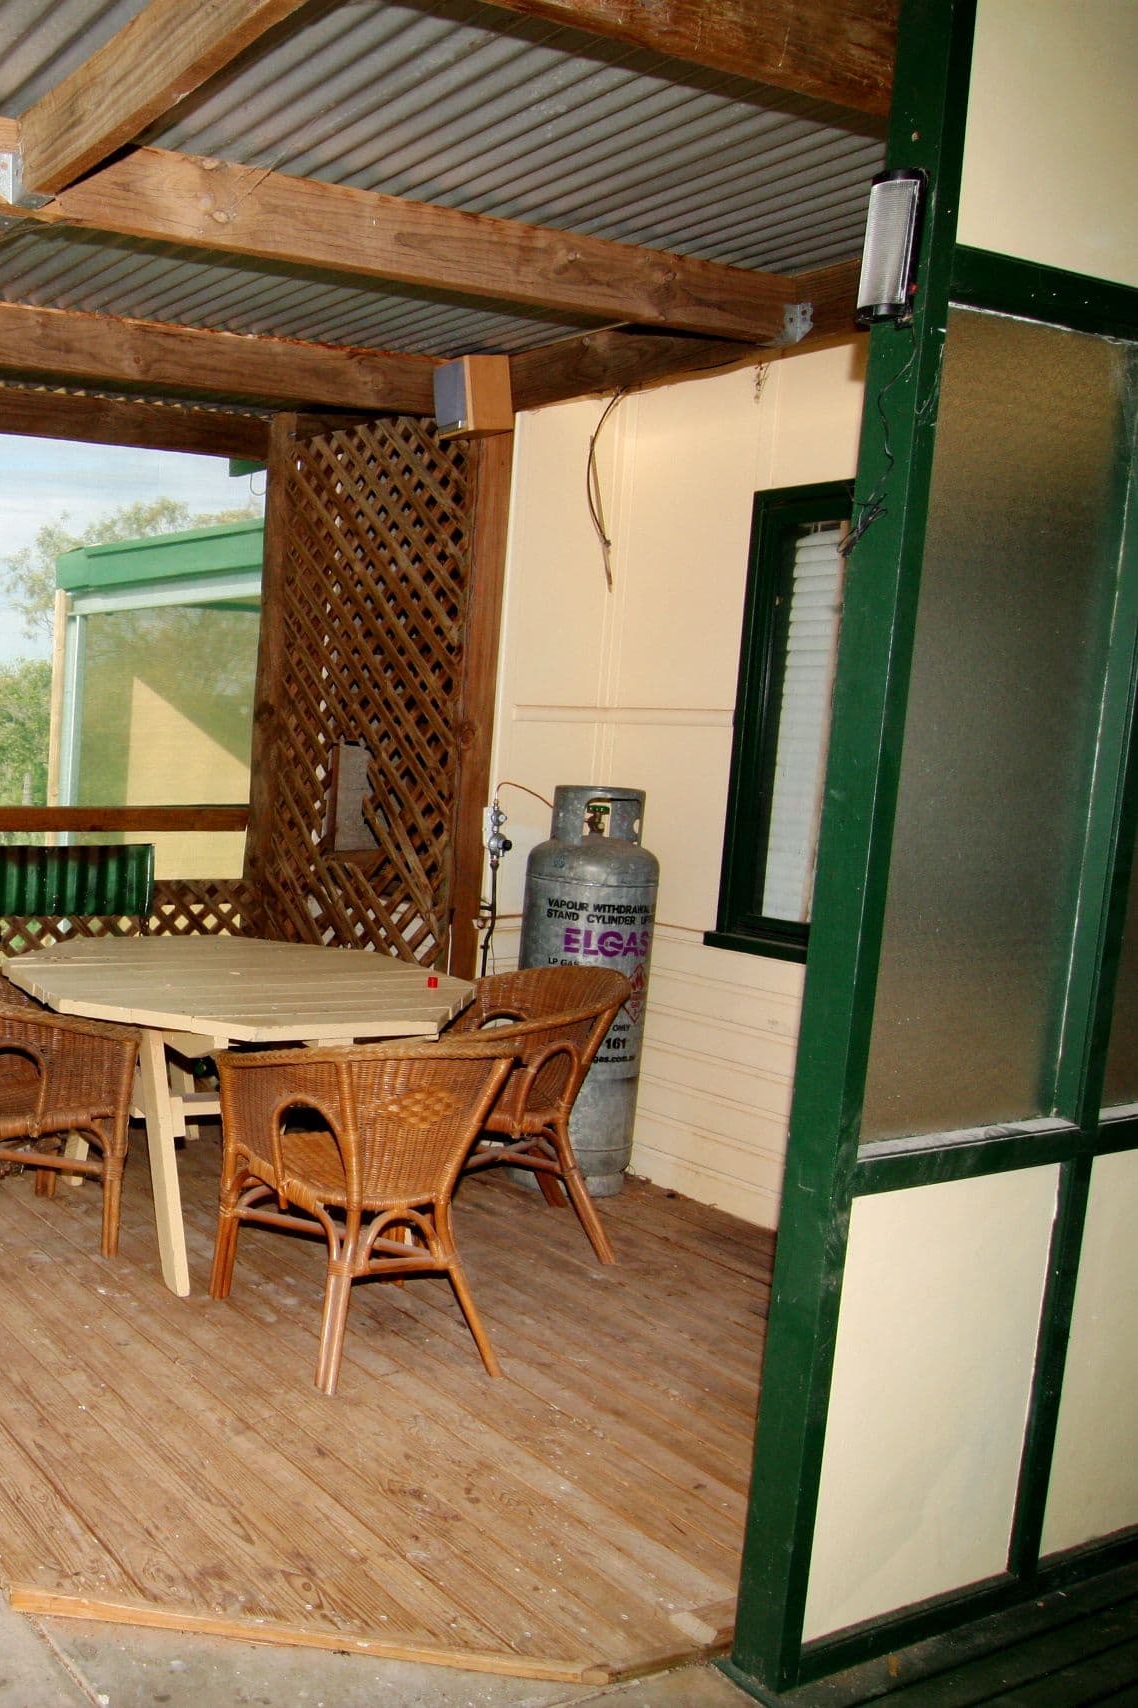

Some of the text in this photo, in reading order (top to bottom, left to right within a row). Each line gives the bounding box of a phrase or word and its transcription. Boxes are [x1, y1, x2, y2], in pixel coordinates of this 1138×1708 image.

[548, 898, 589, 912] VAPOUR
[547, 908, 579, 921] STAND
[587, 914, 636, 925] CYLINDER
[564, 928, 649, 957] ELGAS
[548, 957, 558, 965] LP
[605, 1037, 626, 1050] 161
